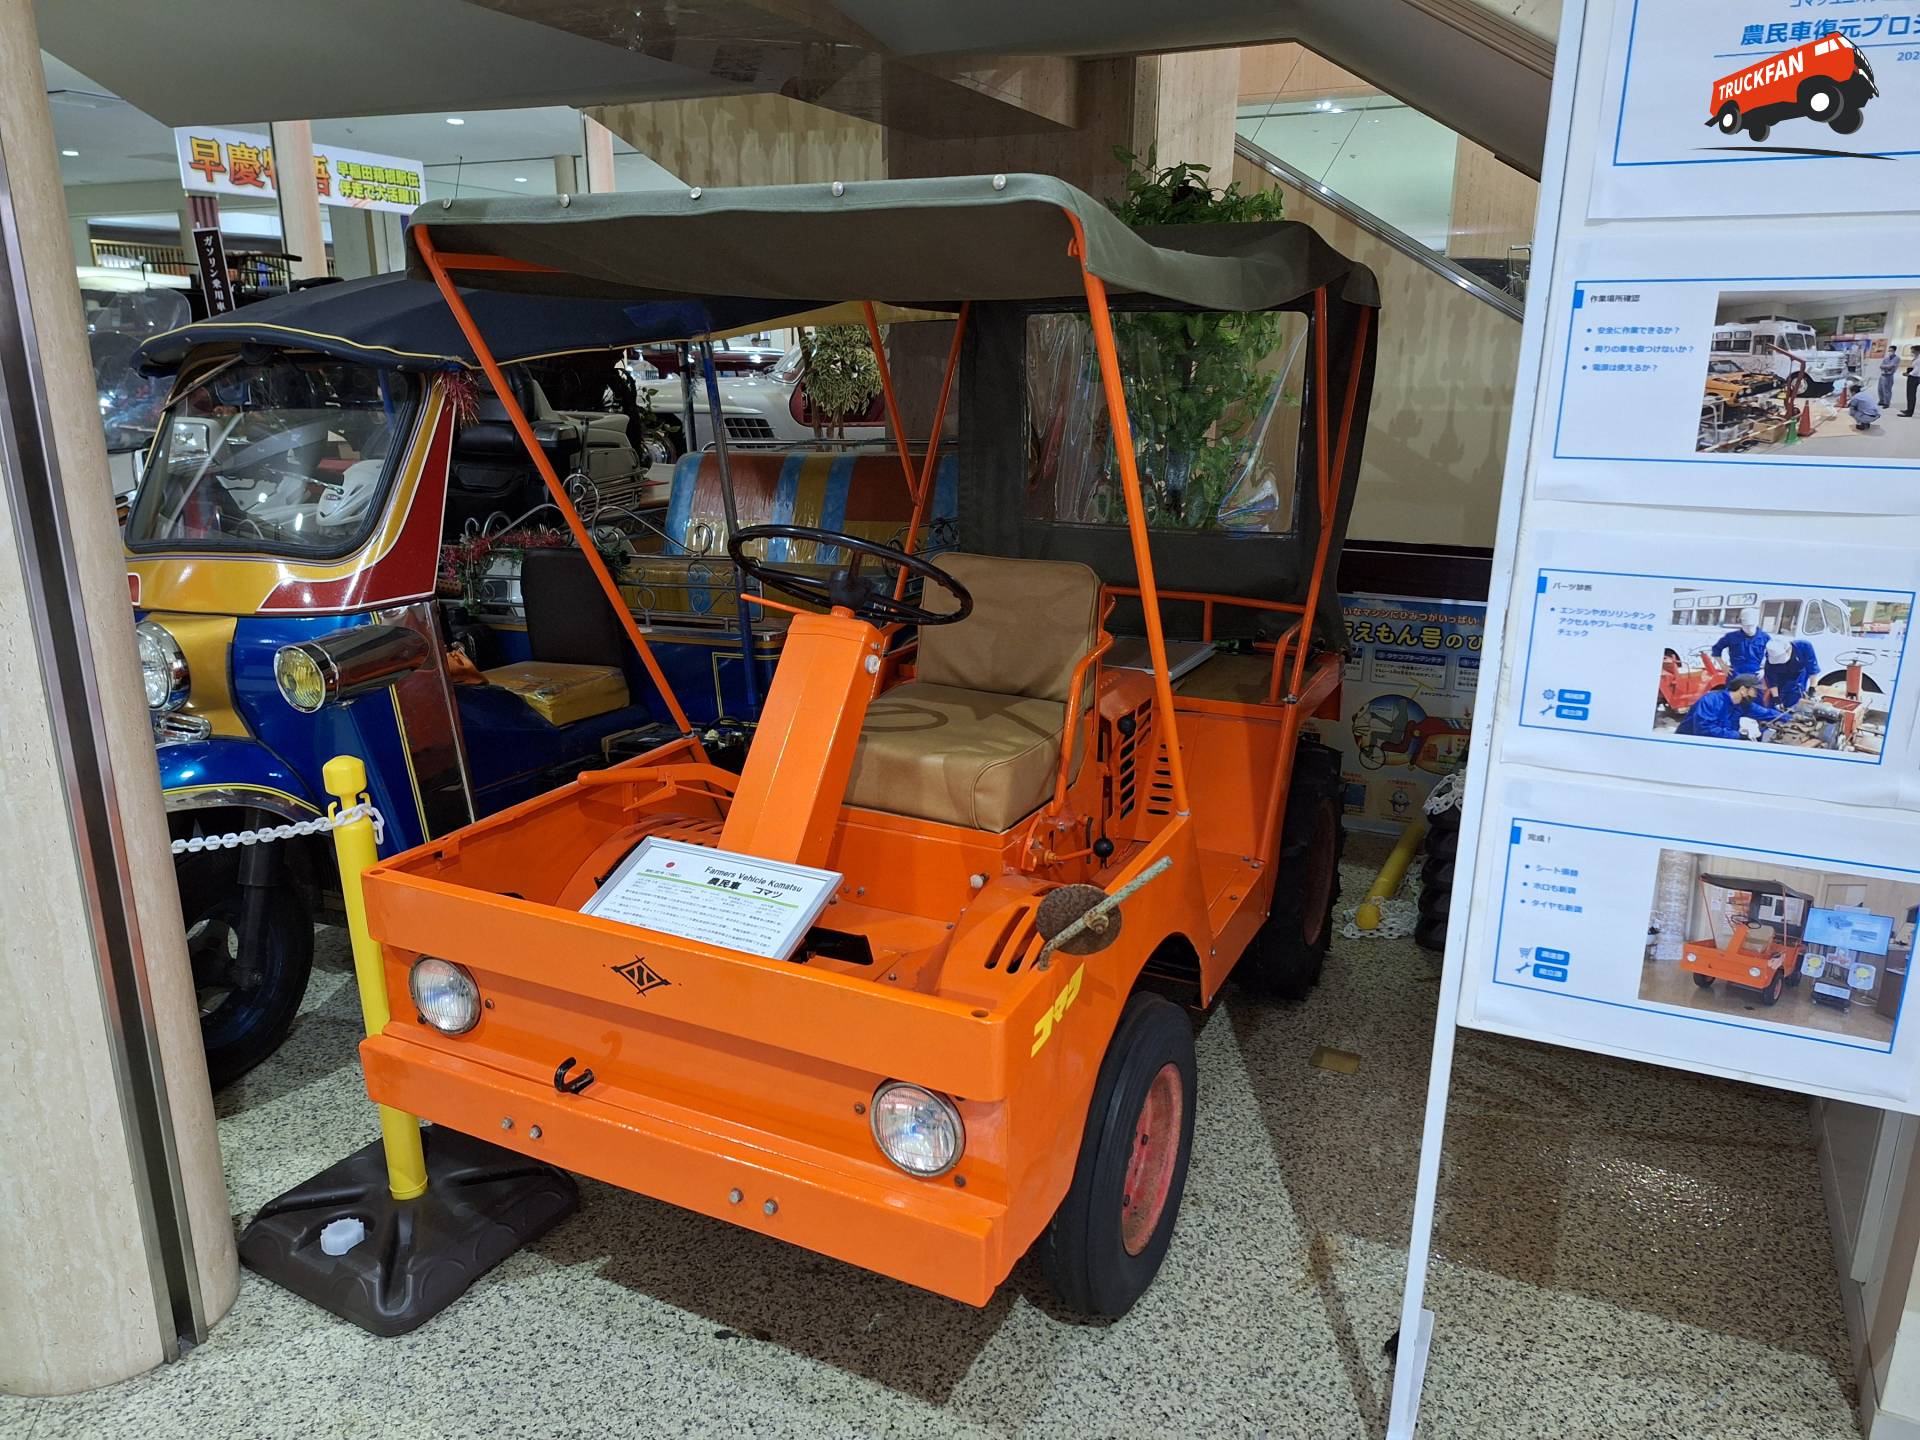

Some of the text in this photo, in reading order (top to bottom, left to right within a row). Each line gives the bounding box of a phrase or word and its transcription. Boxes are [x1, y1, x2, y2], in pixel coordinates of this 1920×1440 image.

[704, 865, 803, 893] Farmers Vehicle Komatsu
[753, 886, 783, 899] コマツ
